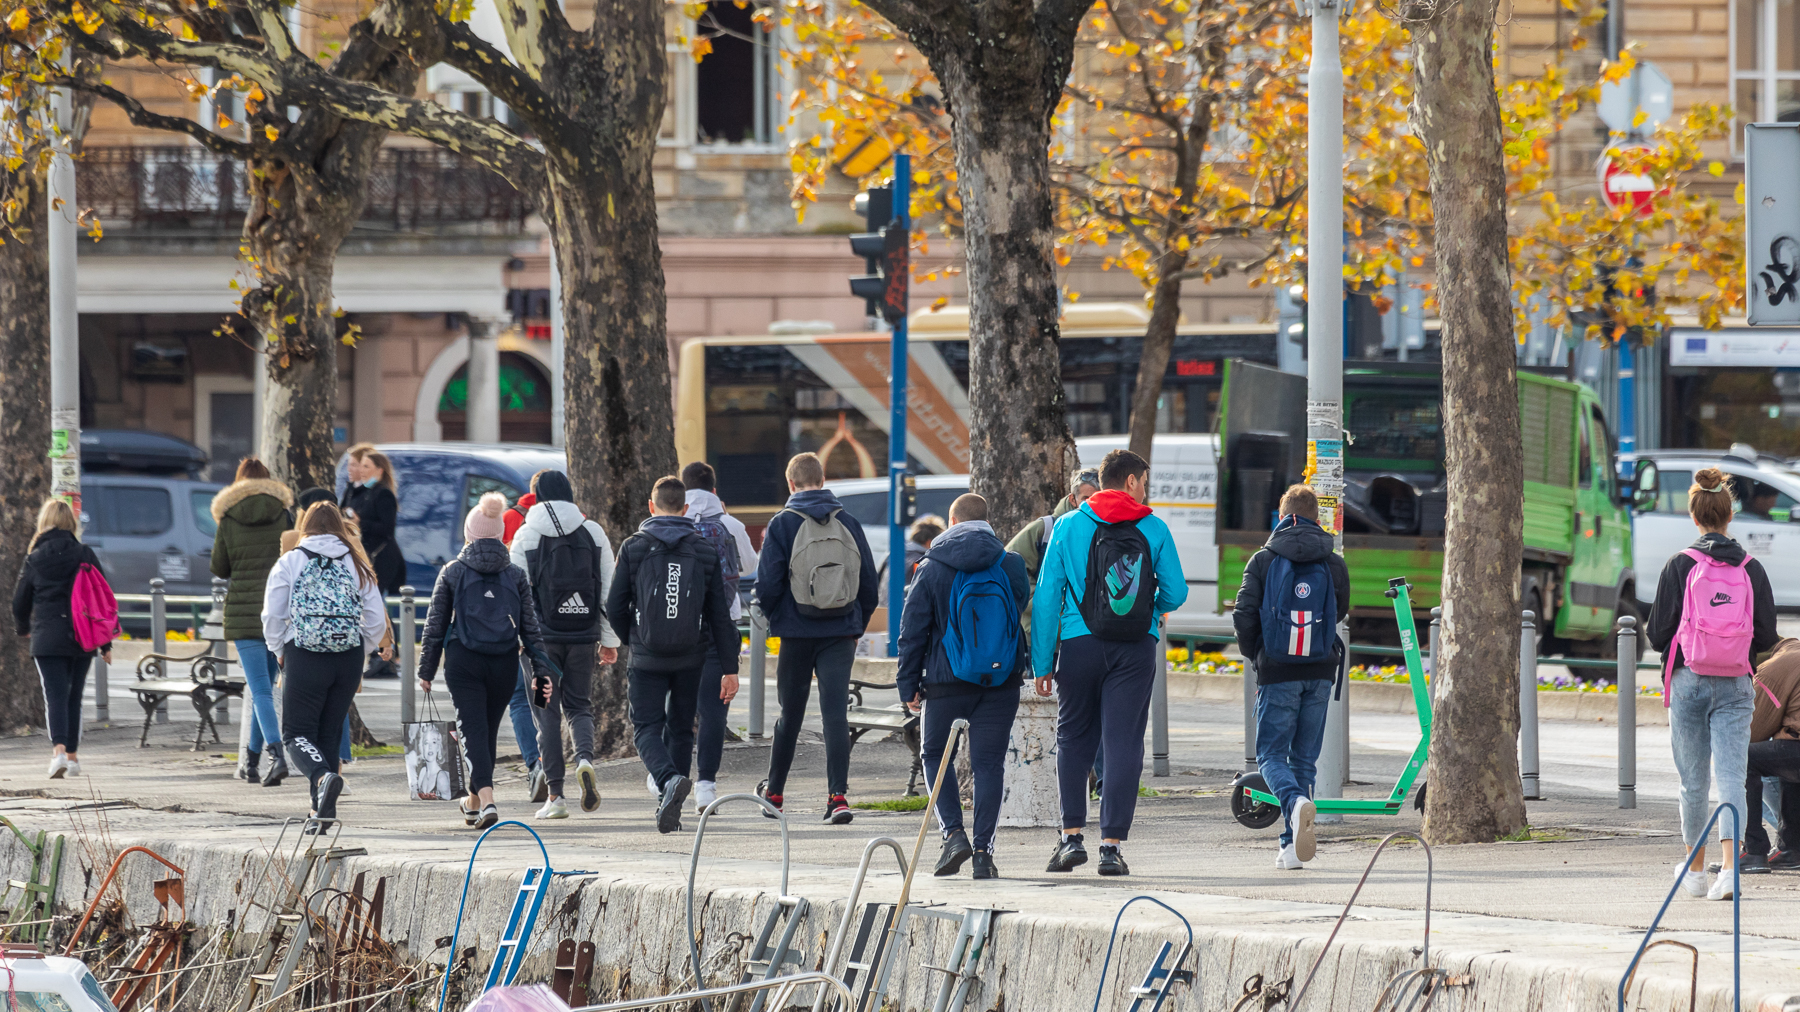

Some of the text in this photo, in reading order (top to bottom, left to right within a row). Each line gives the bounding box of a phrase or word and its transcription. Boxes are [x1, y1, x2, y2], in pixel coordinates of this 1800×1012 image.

[665, 562, 682, 619] Kappa
[1714, 592, 1732, 603] NIKE
[558, 605, 590, 614] adidas
[1401, 629, 1414, 651] Bolt
